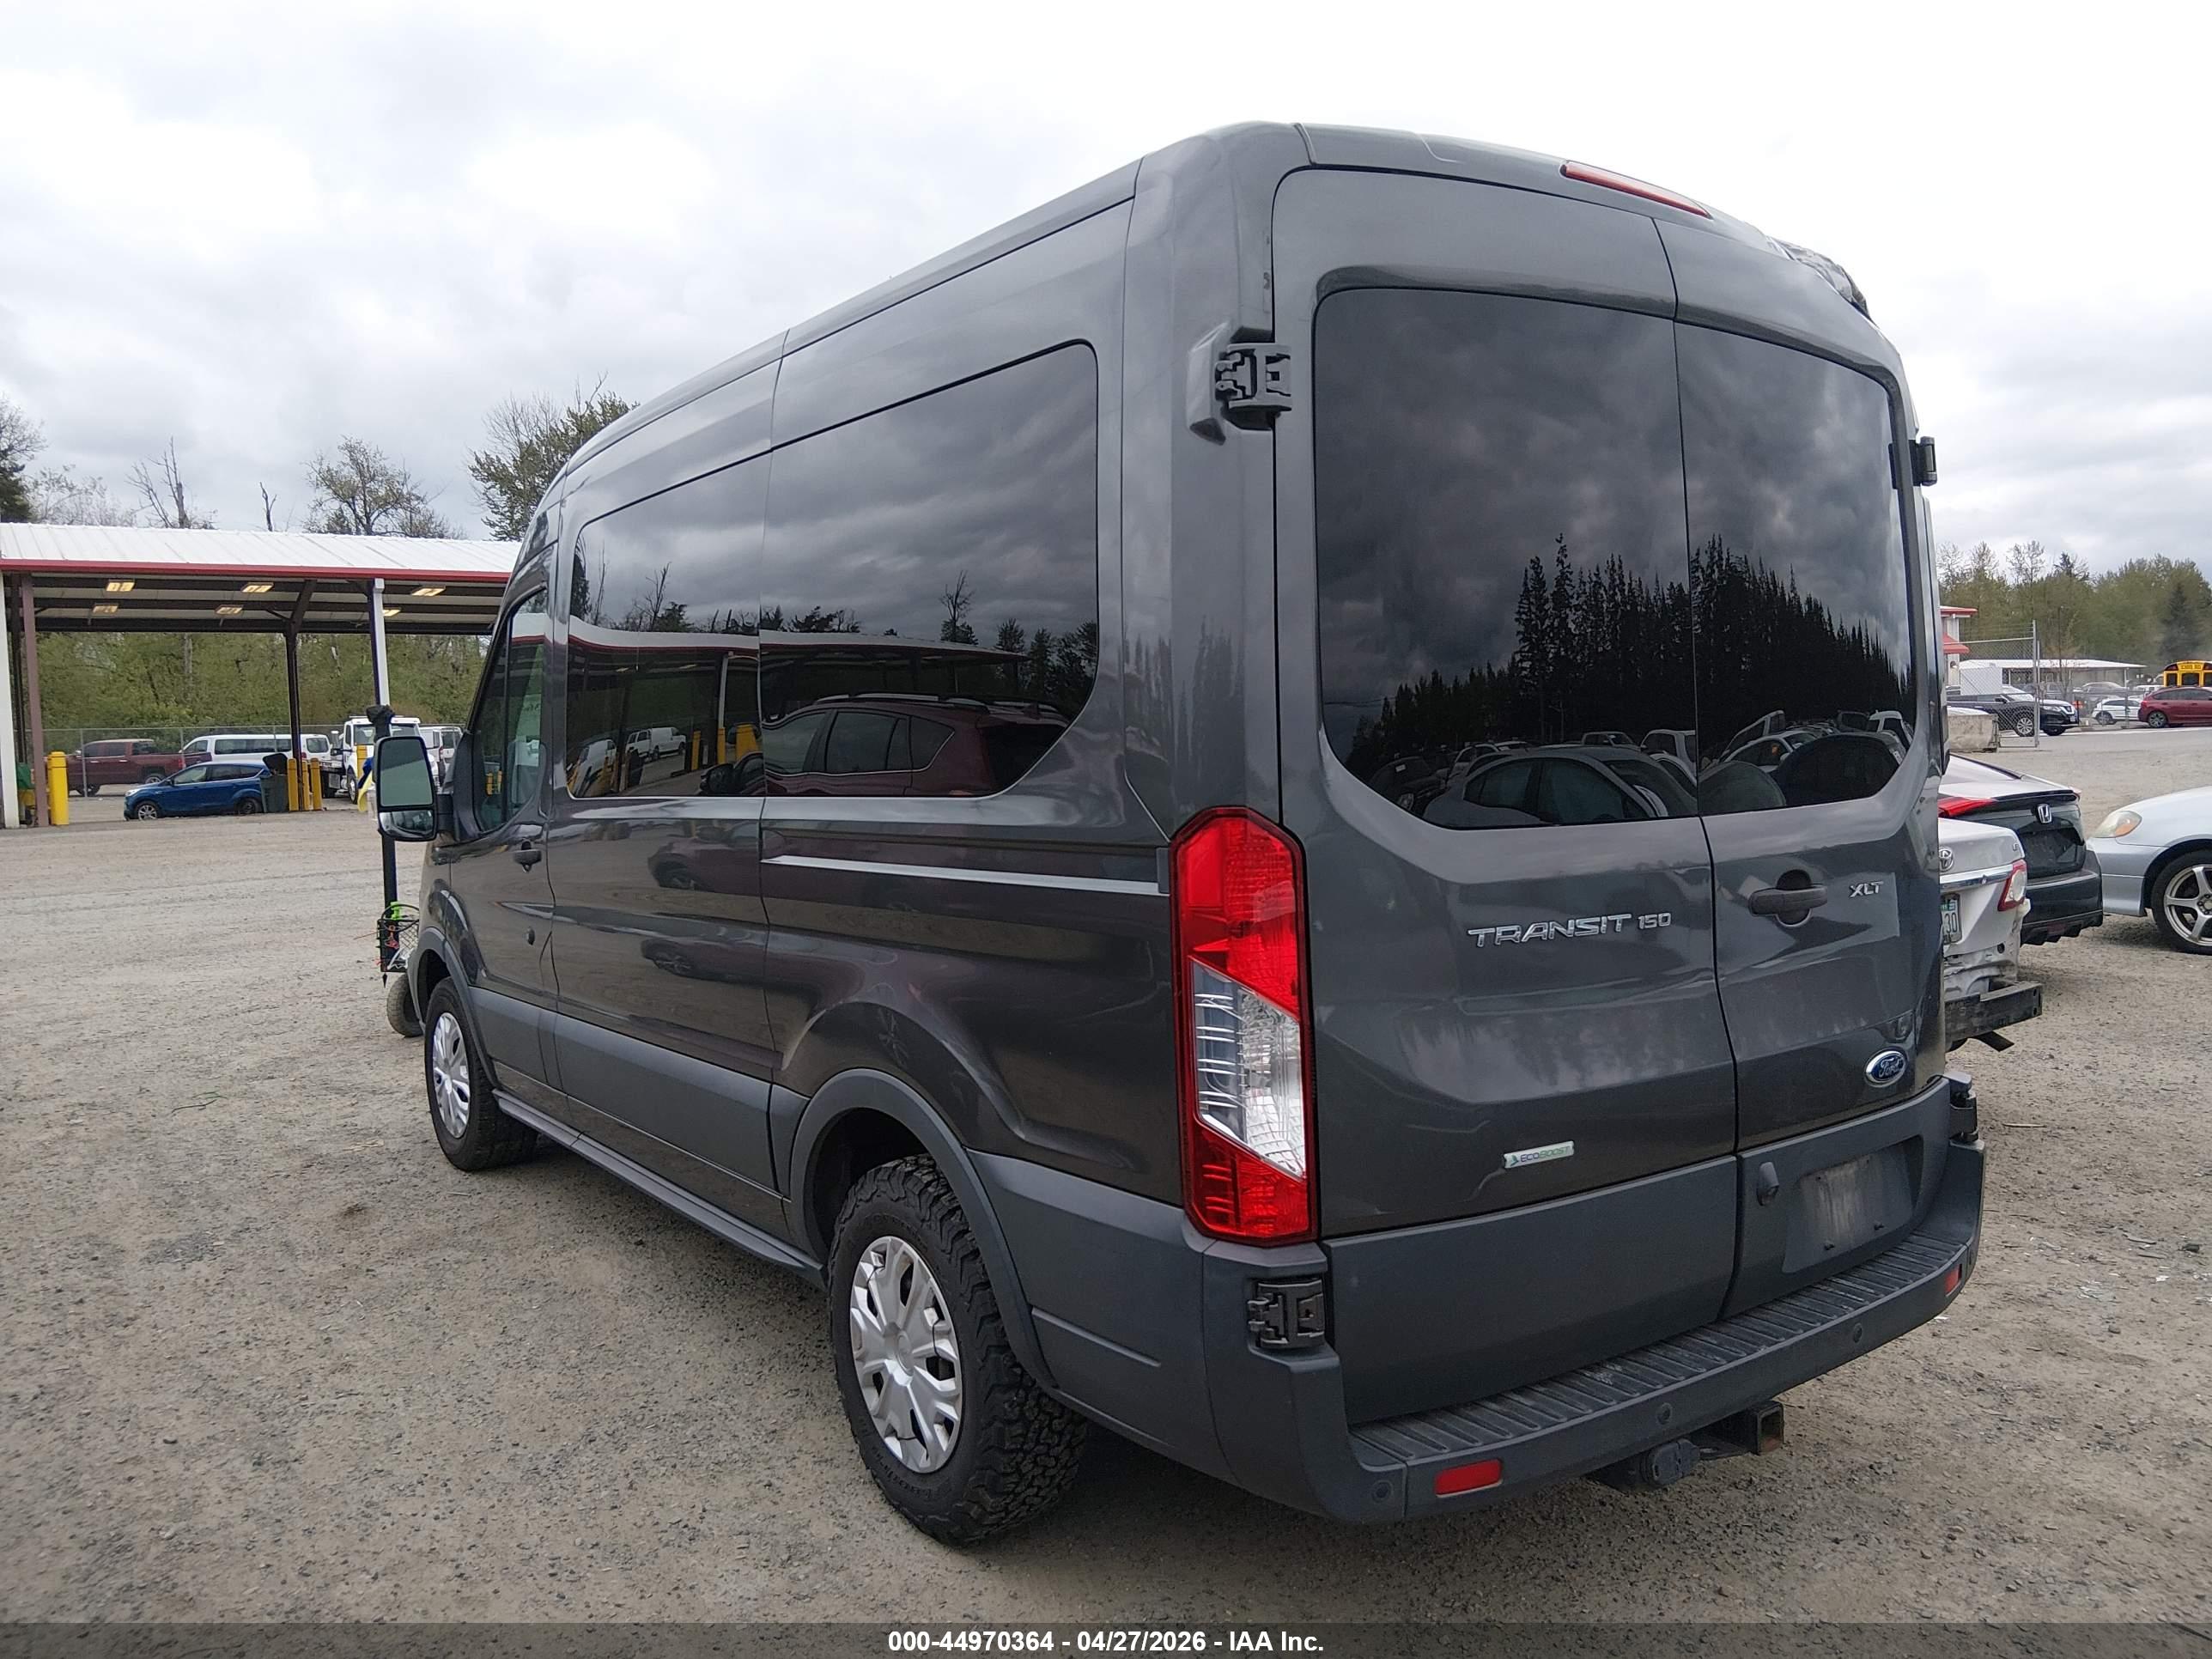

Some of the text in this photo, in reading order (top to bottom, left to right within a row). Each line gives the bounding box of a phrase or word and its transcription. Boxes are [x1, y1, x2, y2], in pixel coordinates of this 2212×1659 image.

[1850, 881, 1884, 897] XLT
[1468, 912, 1672, 947] TRANSIT 150
[1943, 912, 1958, 934] 30
[1878, 1056, 1901, 1078] Ford
